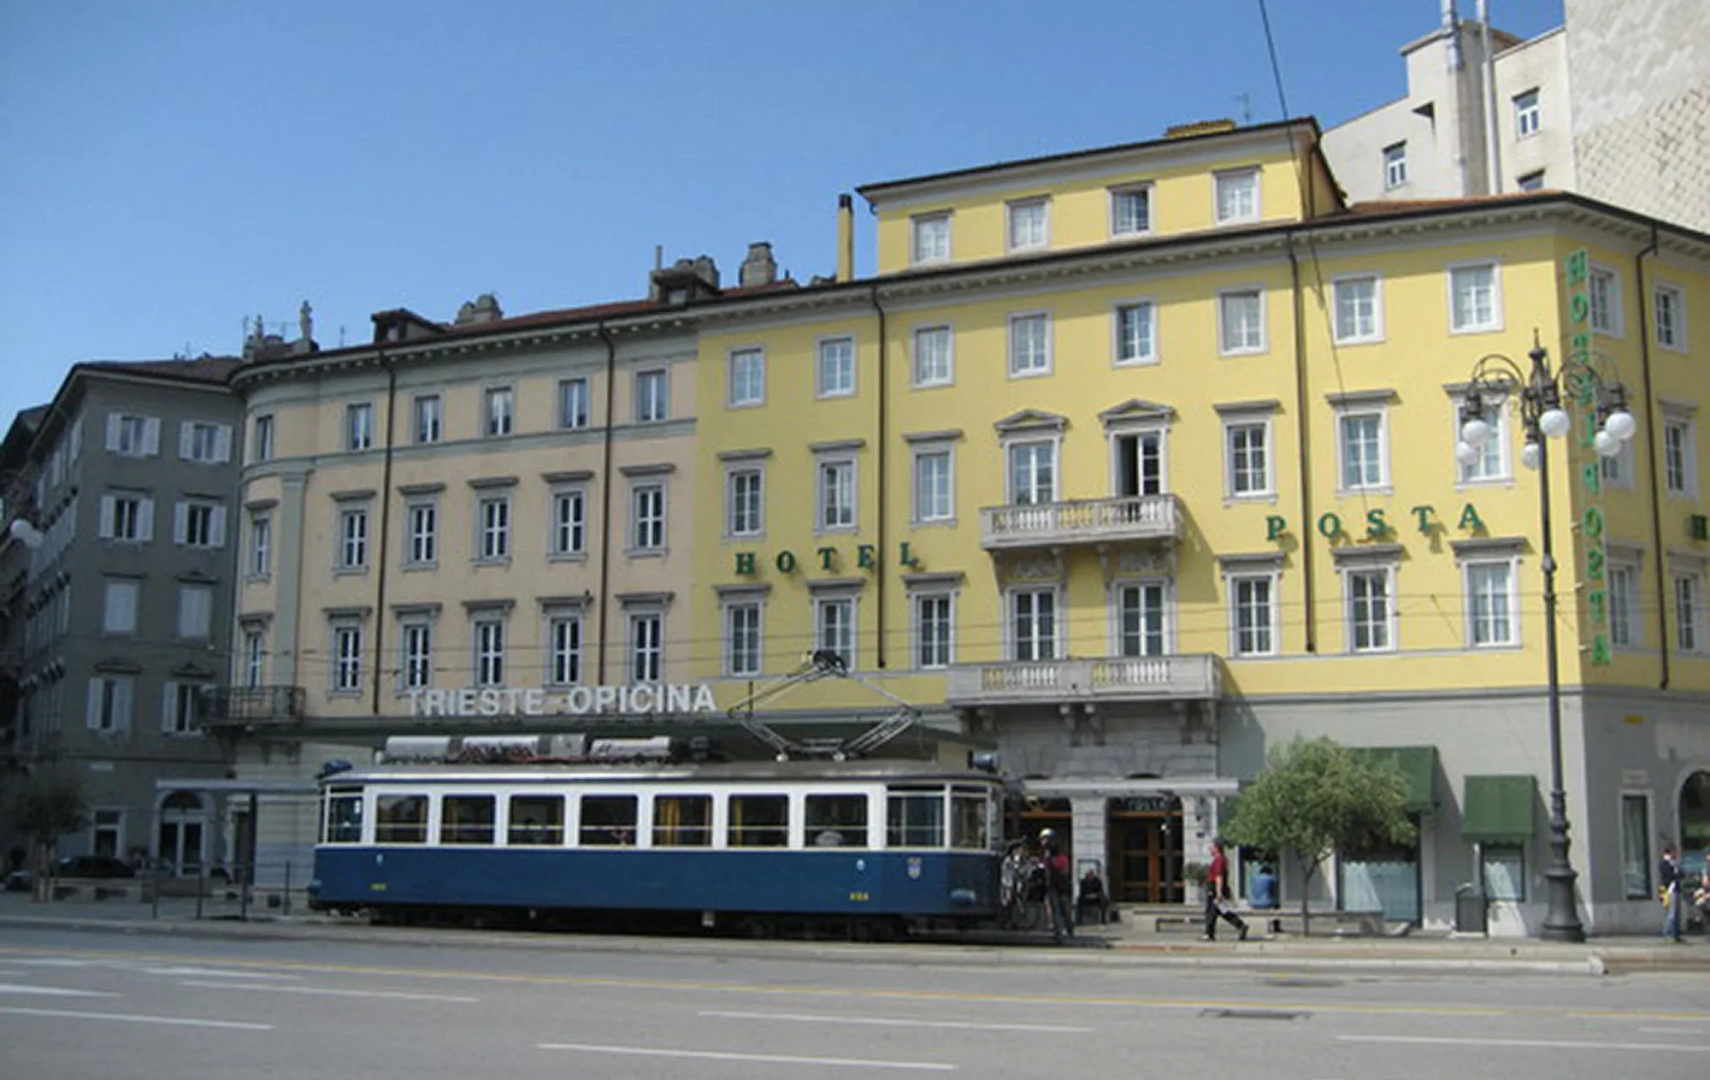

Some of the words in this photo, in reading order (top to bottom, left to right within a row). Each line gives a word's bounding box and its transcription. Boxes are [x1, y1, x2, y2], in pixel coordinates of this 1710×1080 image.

[735, 542, 918, 574] HOTEL
[1266, 503, 1482, 541] POSTA
[406, 687, 544, 716] TRIESTE
[569, 682, 717, 713] OPICINA
